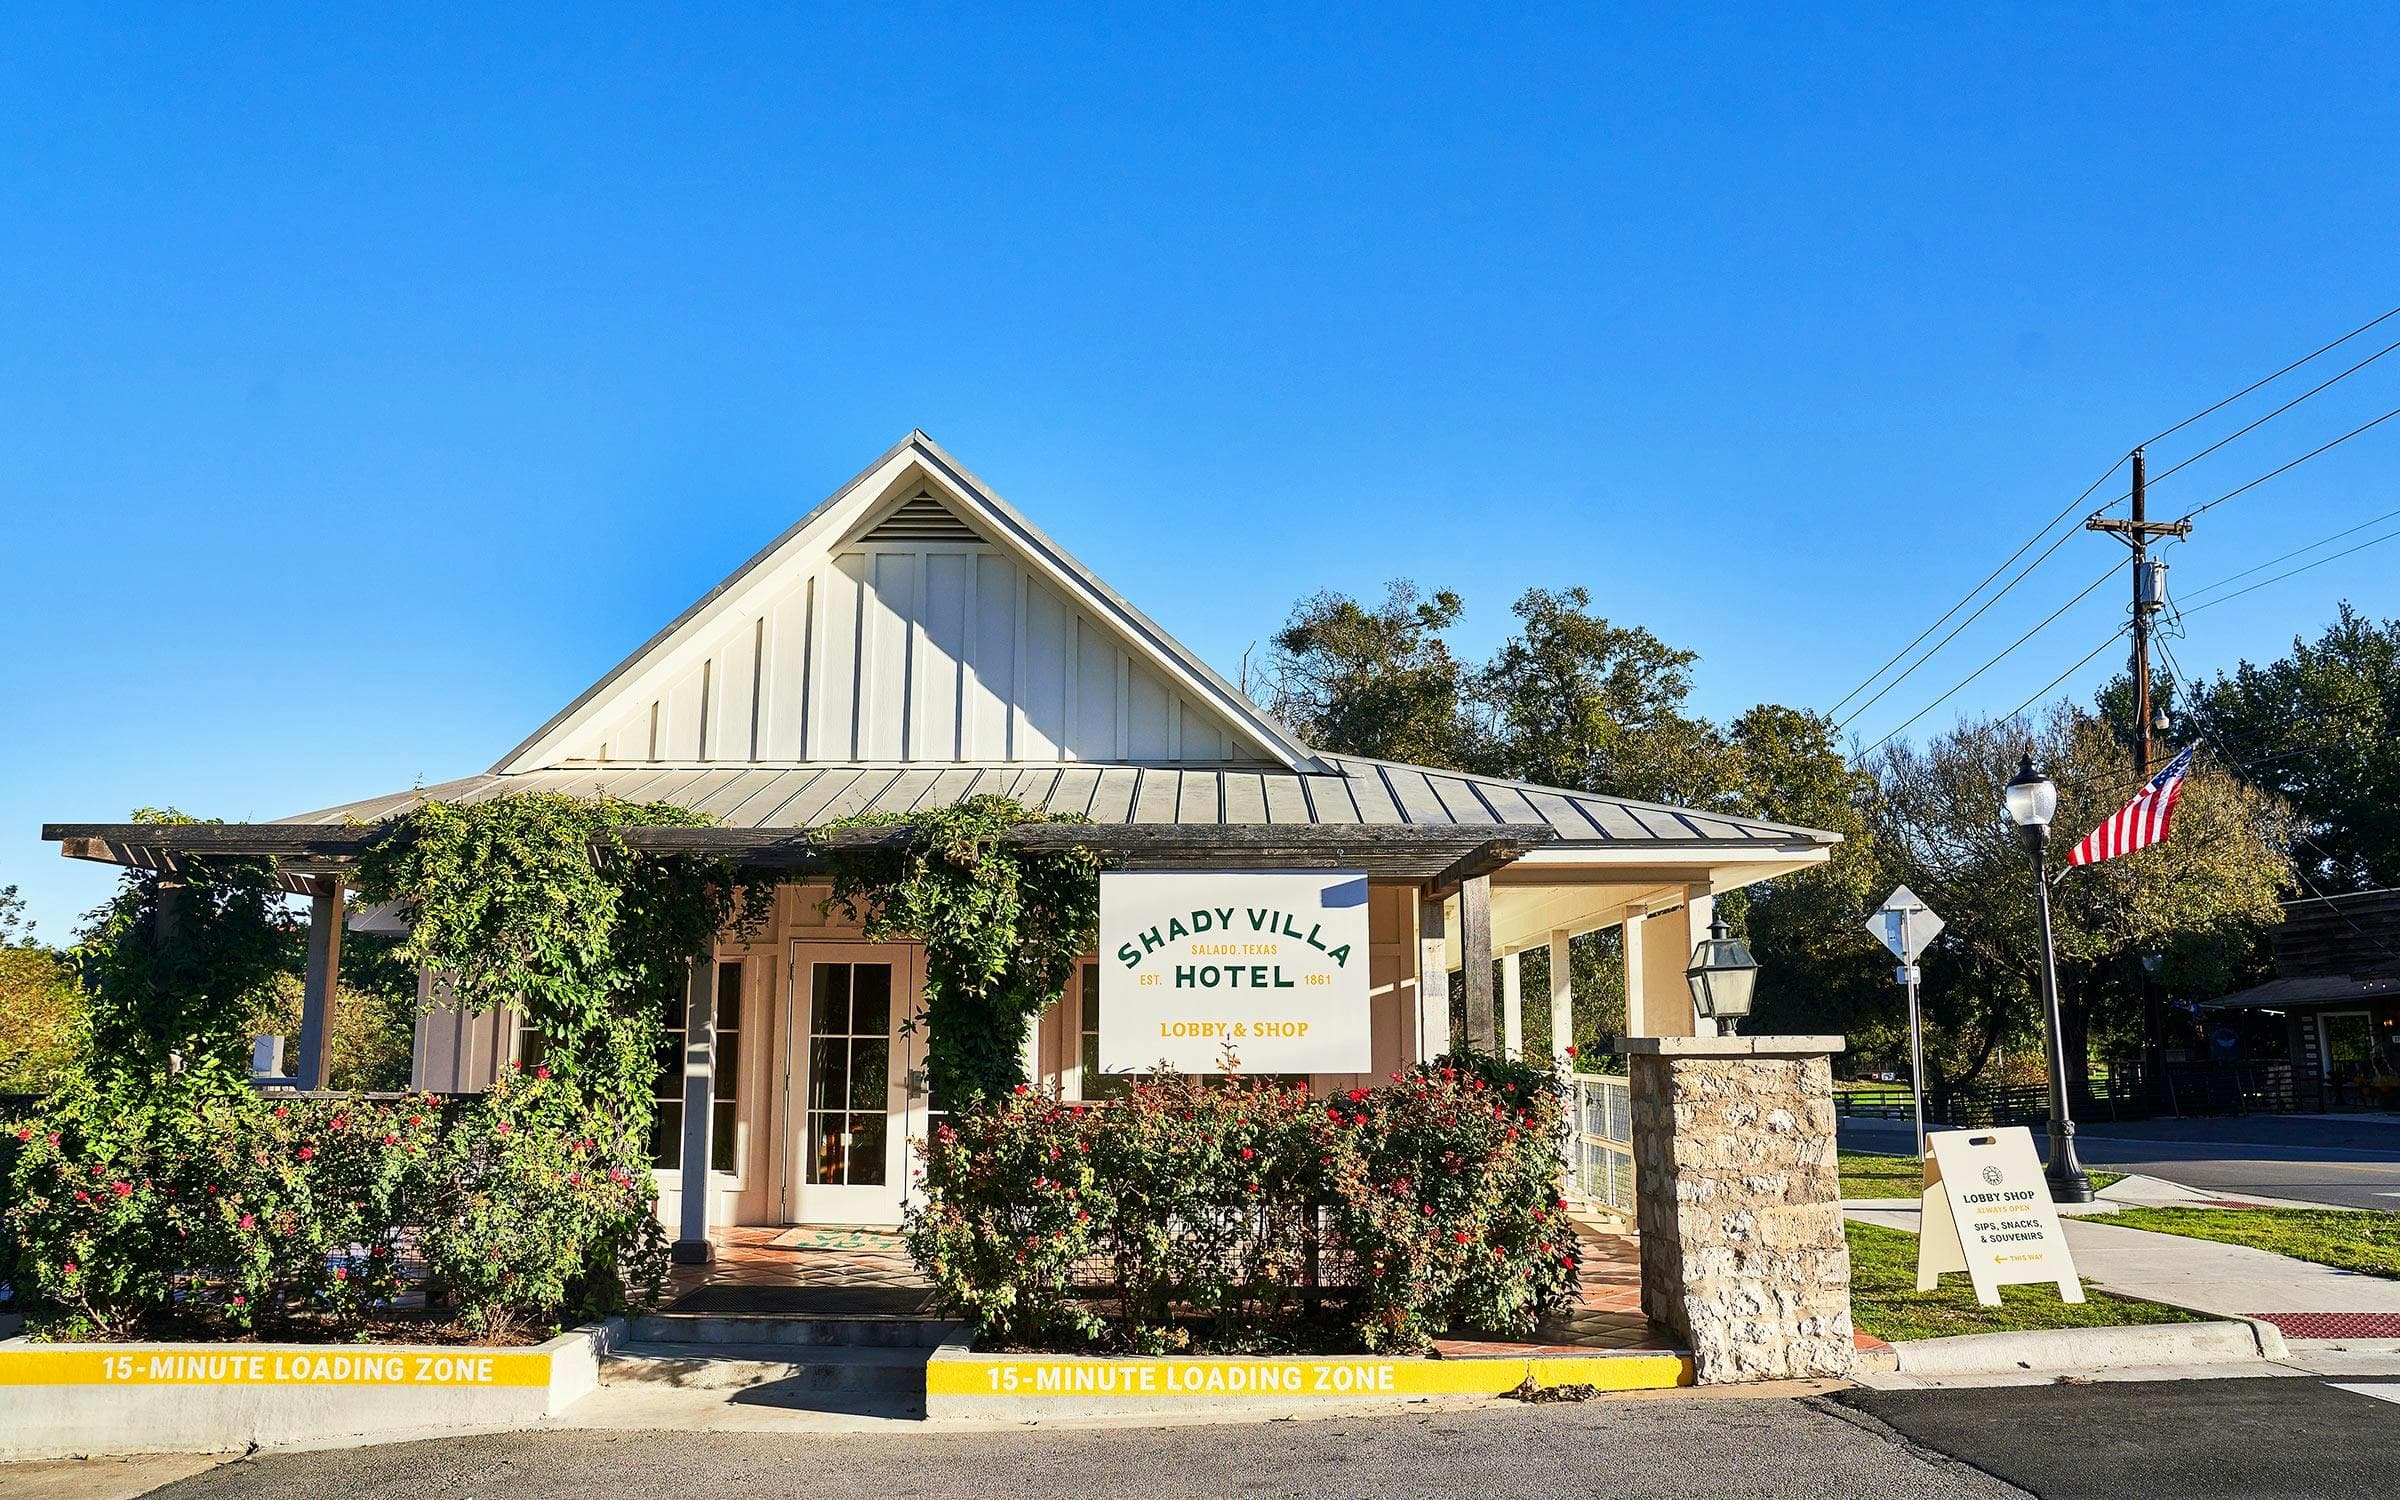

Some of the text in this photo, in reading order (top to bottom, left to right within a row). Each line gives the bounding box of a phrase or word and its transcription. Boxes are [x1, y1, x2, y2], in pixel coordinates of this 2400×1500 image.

[1117, 907, 1352, 970] SHADY VILLA
[1242, 944, 1278, 955] TEXAS
[1140, 974, 1163, 986] EST.
[1175, 965, 1295, 988] HOTEL
[1303, 974, 1332, 986] 1861
[1160, 1022, 1310, 1038] LOBBY & SHOP
[1963, 1190, 2035, 1204] LOBBY SHOP
[1976, 1205, 2031, 1214] ALWAYS OPEN
[1974, 1219, 2043, 1231] SIPS, SNACKS,
[1980, 1231, 2044, 1243] & SOUVENIRS
[2027, 1253, 2043, 1261] WAY
[101, 1357, 493, 1382] 15-MINUTE LOADING ZONE
[987, 1366, 1395, 1391] 15-MINUTE LOADING ZONE
